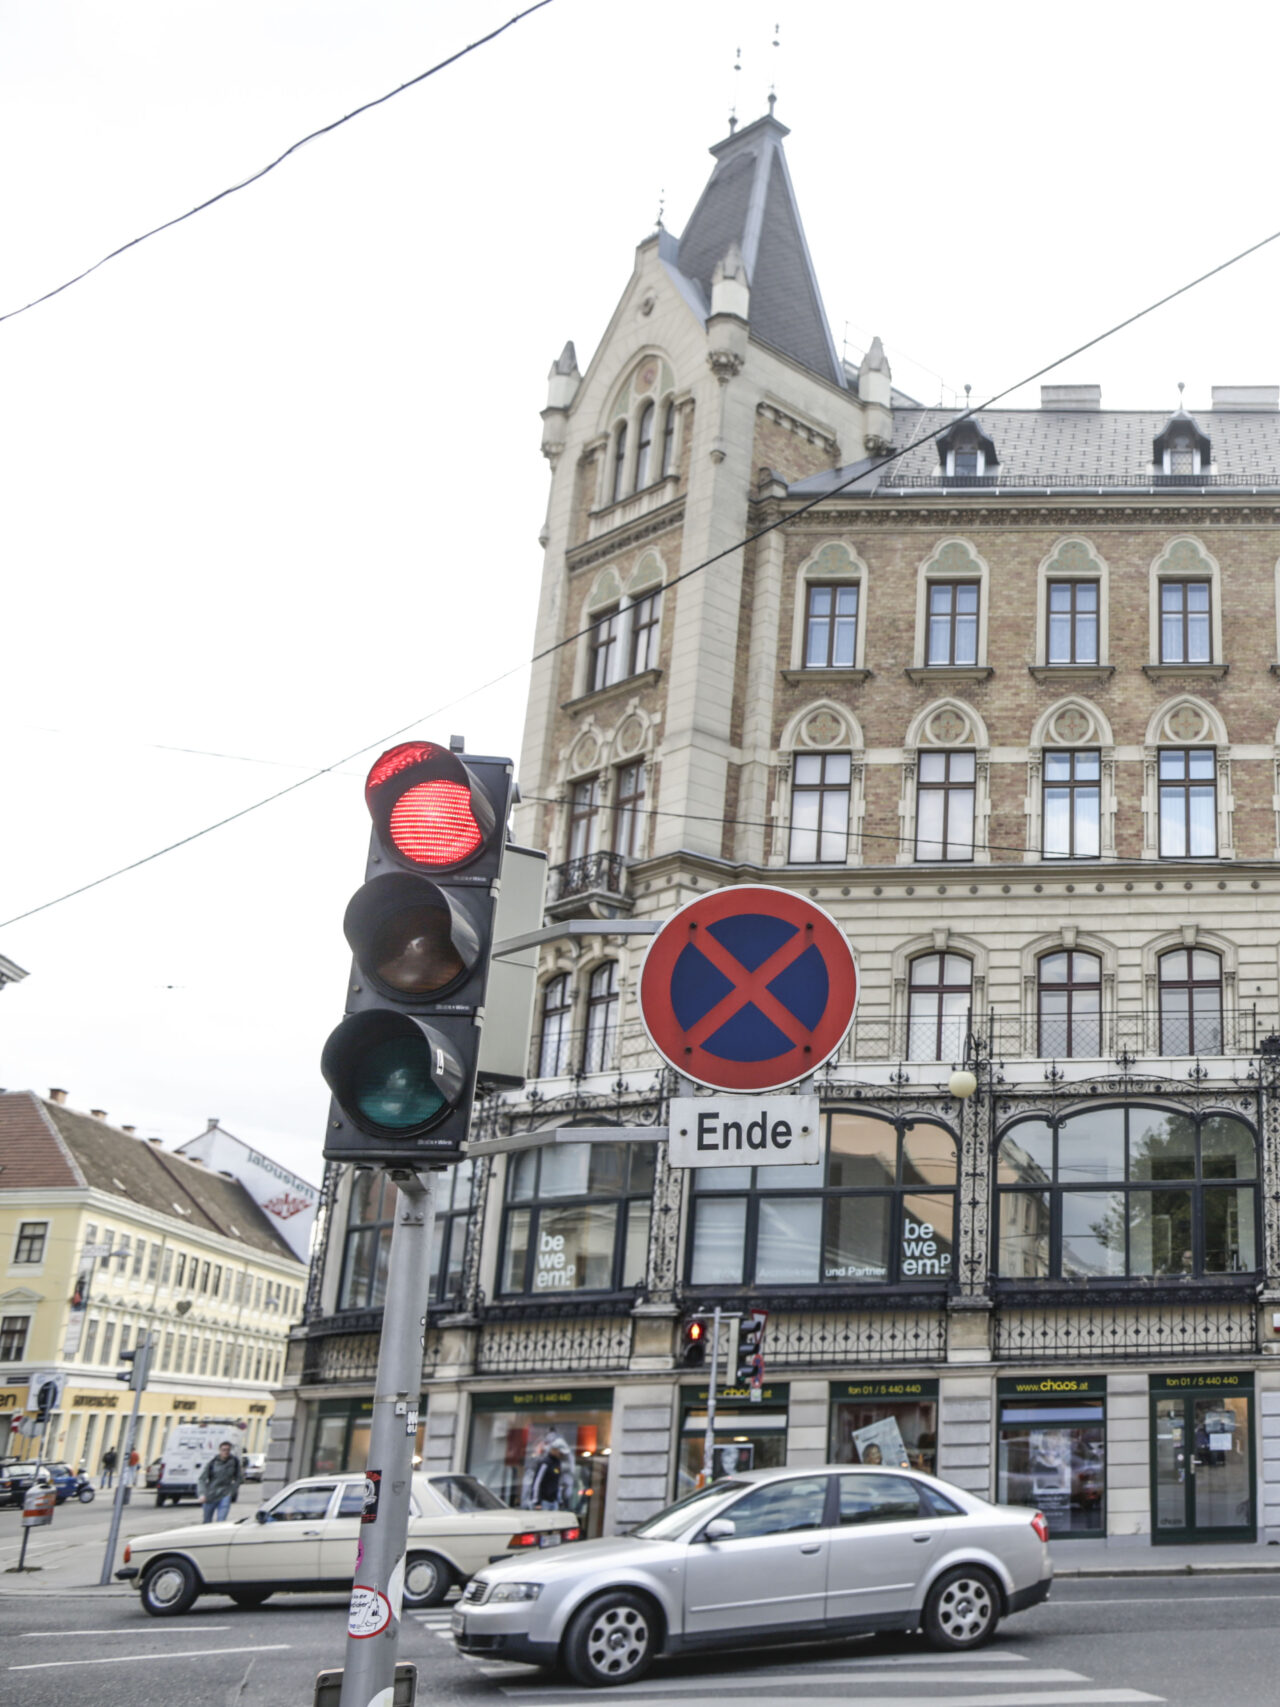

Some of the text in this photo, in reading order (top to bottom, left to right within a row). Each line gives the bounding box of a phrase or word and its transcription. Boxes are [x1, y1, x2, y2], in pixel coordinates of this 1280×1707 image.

[697, 1110, 793, 1151] Ende
[903, 1218, 934, 1239] be
[541, 1231, 565, 1252] be
[902, 1240, 937, 1257] we
[538, 1252, 566, 1269] we
[824, 1266, 846, 1277] und
[847, 1266, 887, 1277] Partner
[1016, 1379, 1089, 1392] www.chaos.at
[1206, 1376, 1221, 1385] 440
[1222, 1375, 1239, 1385] 440
